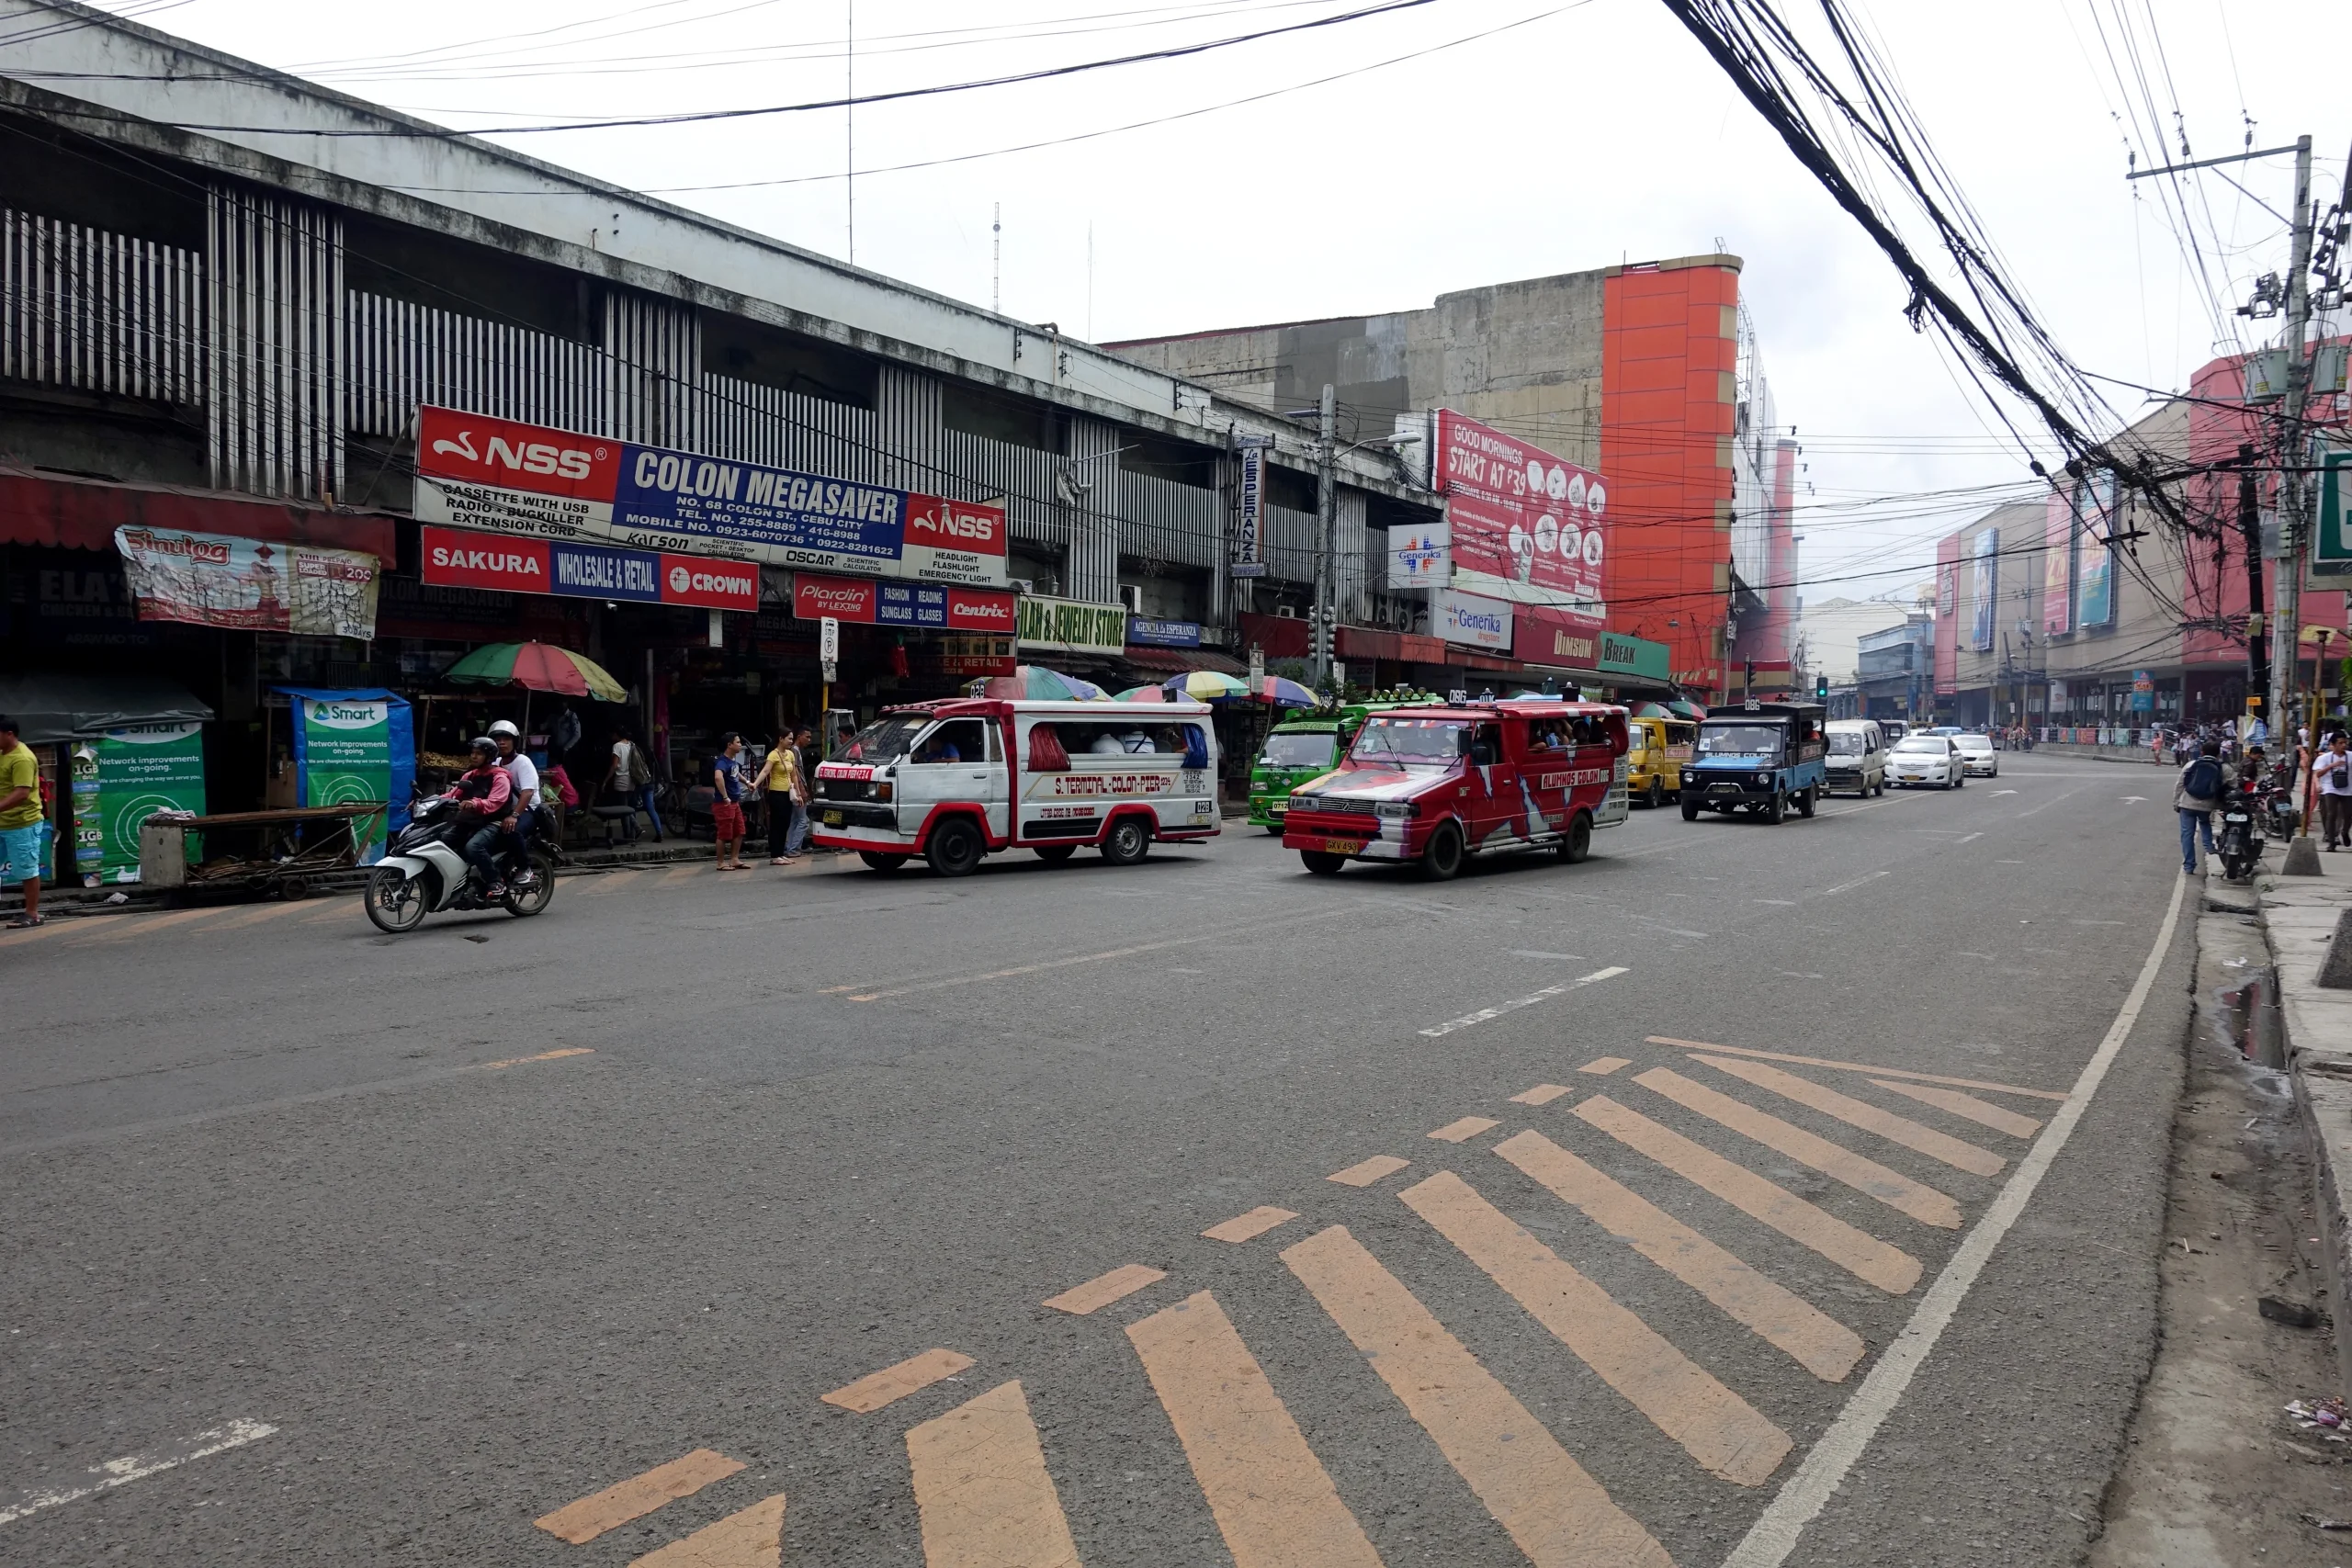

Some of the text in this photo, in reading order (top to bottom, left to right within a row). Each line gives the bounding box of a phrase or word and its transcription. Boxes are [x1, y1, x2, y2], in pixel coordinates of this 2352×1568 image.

[1454, 424, 1523, 467] GOOD MORNINGS
[485, 436, 592, 479] NSS
[1245, 448, 1259, 461] La
[1449, 446, 1486, 483] START
[1489, 461, 1505, 490] AT
[635, 451, 899, 525] COLON MEGASAVER
[443, 484, 590, 513] CASSETTE WITH USB
[447, 498, 584, 525] RADIO BUGKILLER
[676, 496, 864, 530] NO. 68 COLON ST., CEBU CITY
[1241, 460, 1258, 562] ESPERANZA
[453, 513, 576, 536] EXTENSION CORD
[676, 508, 861, 540] TEL. NO. 255-8889 416-8988
[939, 513, 992, 540] NSS
[626, 513, 894, 556] MOBILE NO. 0923-6070736 0922-8281622
[712, 538, 745, 547] SCIENTIFIC
[127, 530, 231, 565] Sinulog
[707, 549, 745, 558] CALCULATOR
[729, 546, 755, 554] DESKTOP
[1399, 551, 1442, 560] Generika
[433, 547, 540, 575] SAKURA
[786, 550, 835, 566] OSCAR
[846, 557, 880, 566] SCIENTIFIC
[935, 551, 978, 563] HEADLIGHT
[299, 561, 326, 570] SUPER
[299, 568, 327, 576] LOADED
[558, 553, 655, 592] WHOLESALE & RETAIL
[843, 563, 882, 572] CALCULATOR
[933, 561, 980, 573] FLASHLIGHT
[692, 573, 752, 595] CROWN
[919, 569, 992, 583] EMERGENCY LIGHT
[817, 600, 827, 608] BY
[885, 588, 943, 604] FASHION READING
[881, 605, 943, 622] SUNGLASS GLASSES
[953, 603, 1008, 618] Centrix
[1044, 604, 1125, 648] & JEWELRY STORE
[1134, 621, 1159, 633] AGENCIA
[1167, 624, 1197, 637] ESPERANZA
[1459, 609, 1500, 633] Generika
[1477, 632, 1500, 643] drugstore
[1554, 629, 1636, 664] DIMSUM BREAK
[965, 658, 1003, 668] RETAIL
[332, 705, 376, 721] Smart
[340, 740, 388, 749] improvements
[99, 755, 199, 766] Network improvements
[129, 764, 172, 773] on-going.
[74, 763, 99, 776] 1GB
[1066, 776, 1108, 795] TERMINAL
[1112, 775, 1137, 793] COLON
[1140, 774, 1160, 793] PIER
[1544, 770, 1599, 788] ALUMNOS COLON
[78, 830, 103, 842] 1GB
[1328, 840, 1357, 852] GXV 493
